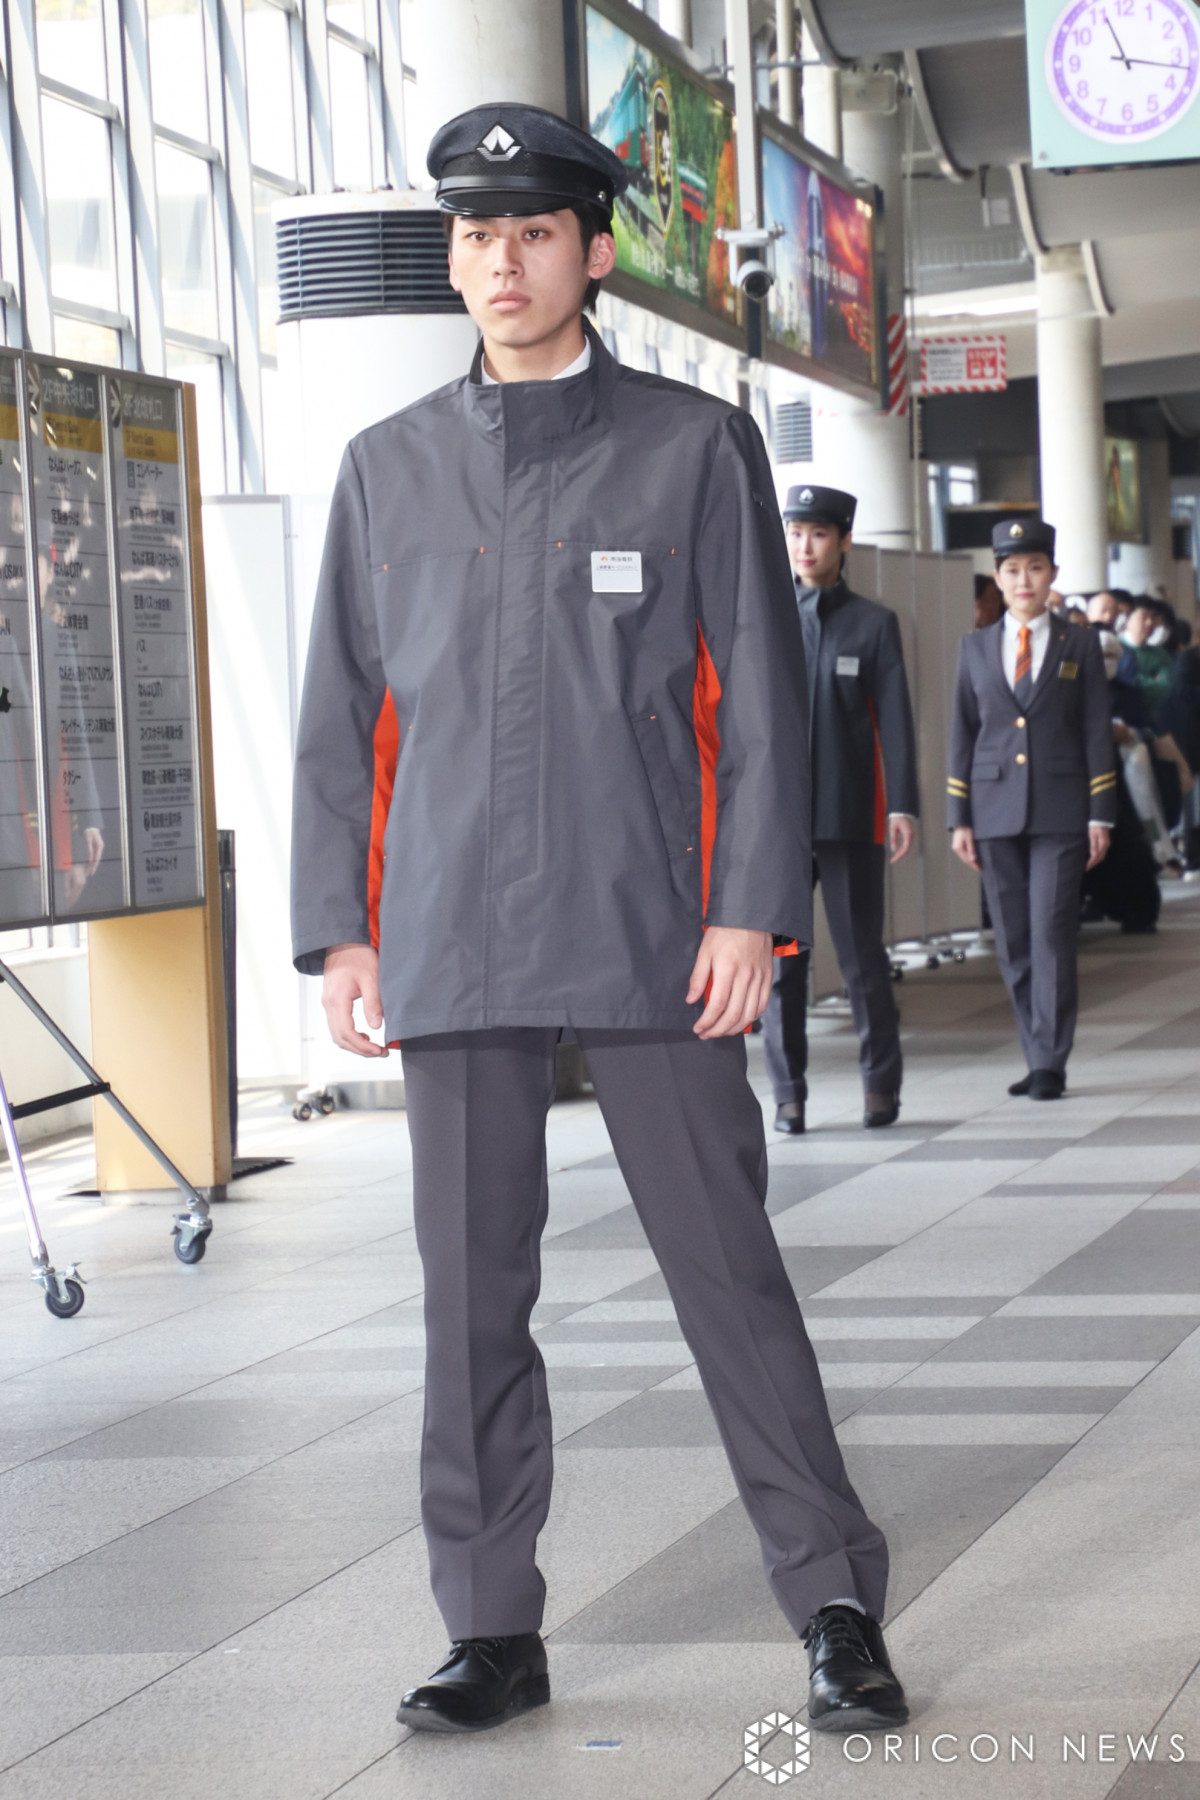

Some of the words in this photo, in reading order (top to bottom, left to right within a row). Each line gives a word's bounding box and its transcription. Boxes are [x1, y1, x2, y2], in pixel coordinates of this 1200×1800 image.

[1090, 7, 1108, 25] 11
[1114, 0, 1134, 16] 12
[1144, 3, 1153, 21] 1
[1071, 27, 1092, 46] 10
[1163, 20, 1175, 40] 2
[1069, 55, 1081, 73] 9
[1171, 47, 1183, 67] 3
[1077, 79, 1089, 99] 8
[1164, 73, 1176, 91] 4
[1096, 97, 1108, 116] 7
[1121, 102, 1134, 121] 6
[1147, 94, 1159, 113] 5
